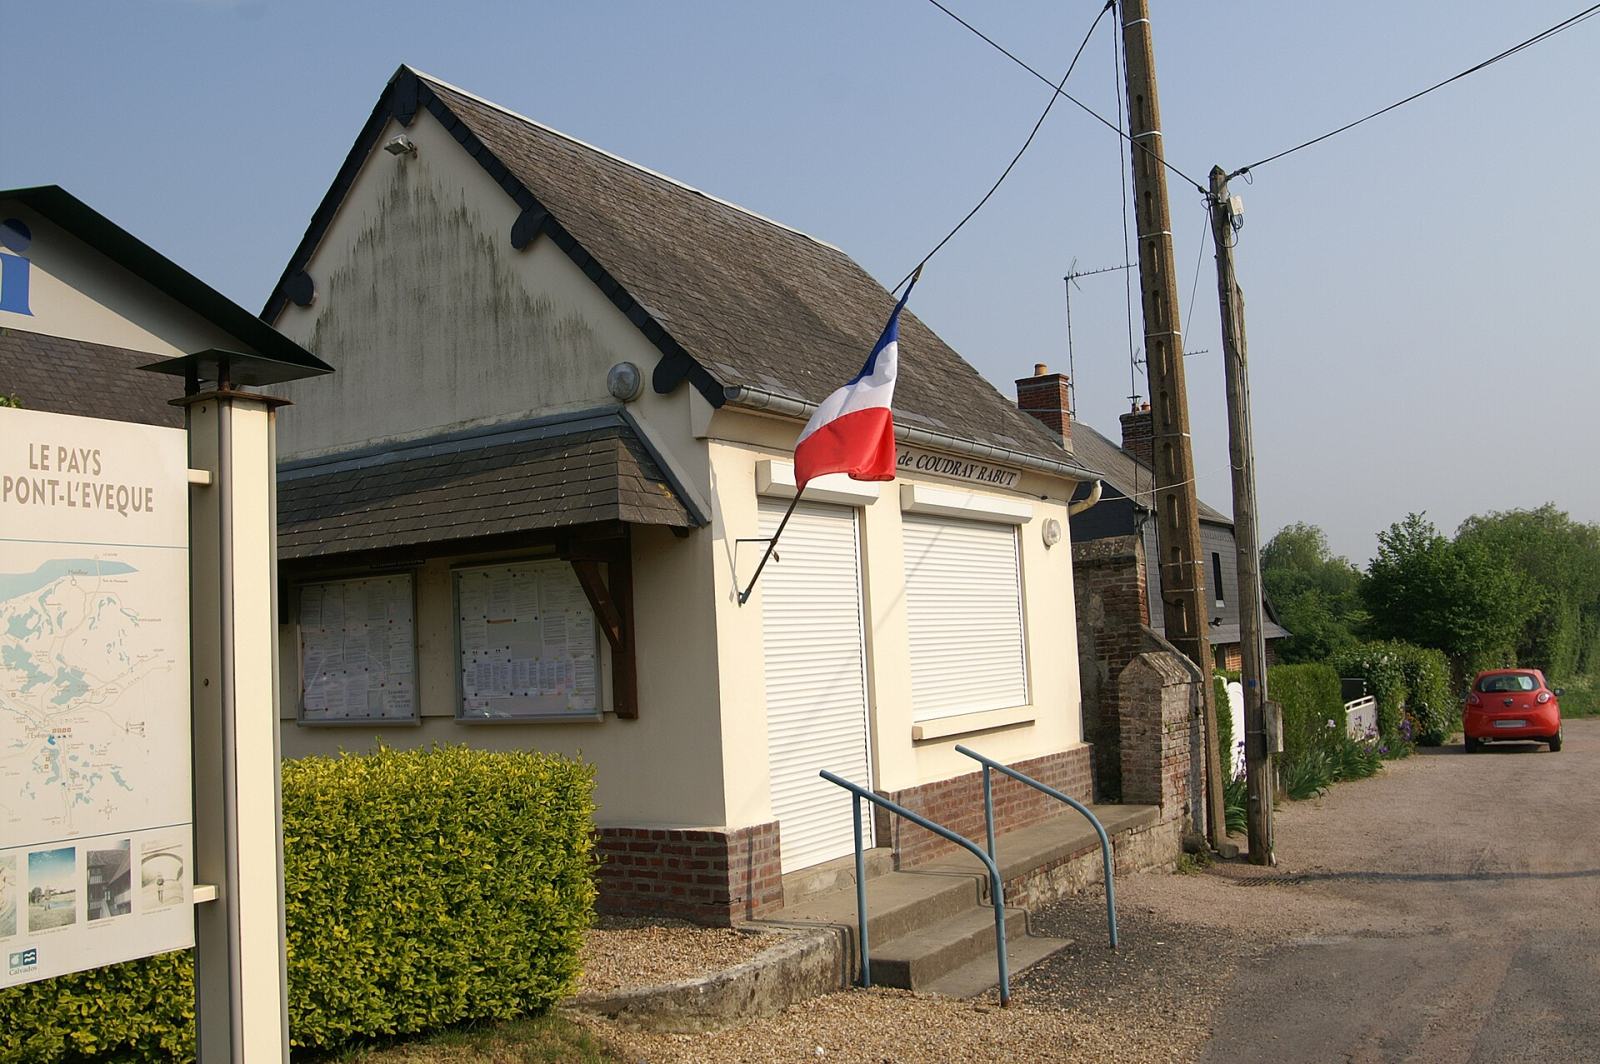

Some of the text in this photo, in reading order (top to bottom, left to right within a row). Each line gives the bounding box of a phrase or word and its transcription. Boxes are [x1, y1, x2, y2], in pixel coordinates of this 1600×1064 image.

[29, 443, 102, 476] LE PAYS
[898, 450, 1017, 486] de COUDRAY RABUT
[3, 475, 154, 518] PONT-L'EVEQUE
